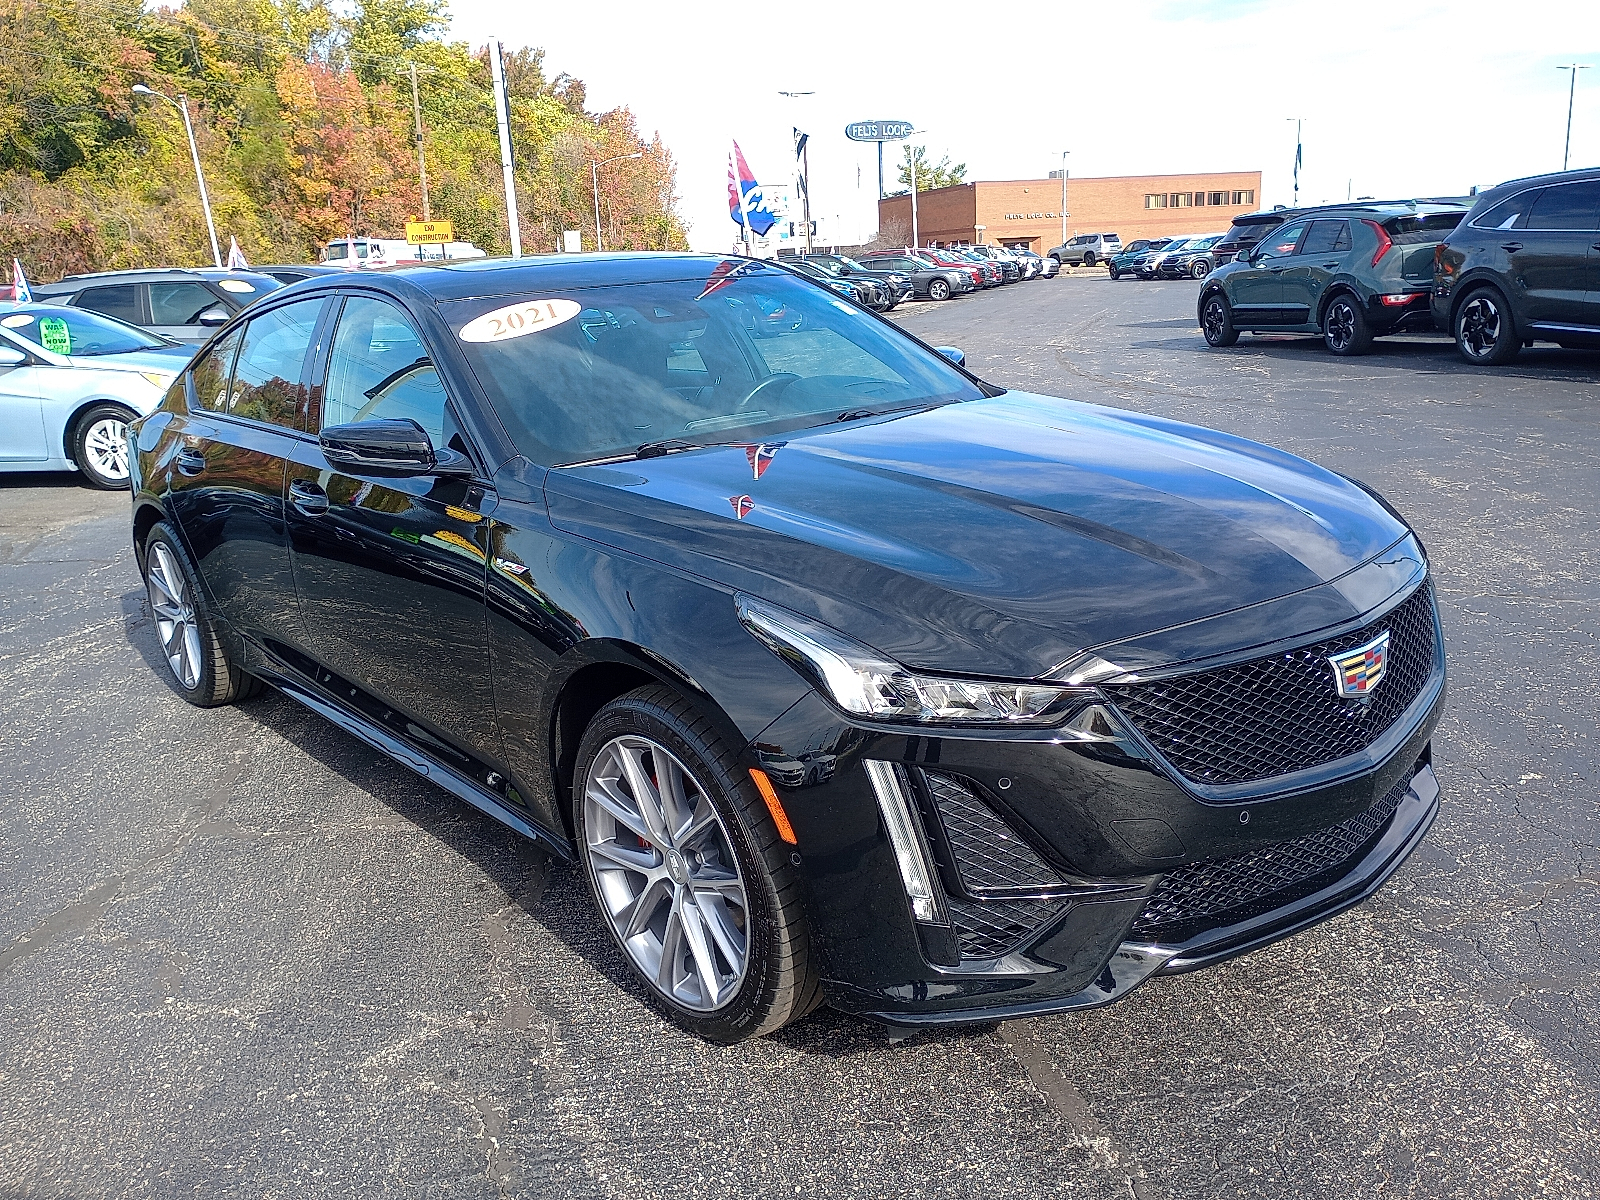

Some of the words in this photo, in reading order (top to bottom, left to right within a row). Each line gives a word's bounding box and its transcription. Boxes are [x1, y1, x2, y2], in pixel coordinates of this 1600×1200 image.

[852, 124, 878, 137] FELTS
[882, 124, 907, 136] LOCK
[424, 224, 435, 232] END
[411, 233, 449, 242] CONSTRUCTION
[488, 303, 558, 337] 2021
[44, 324, 65, 332] WAS
